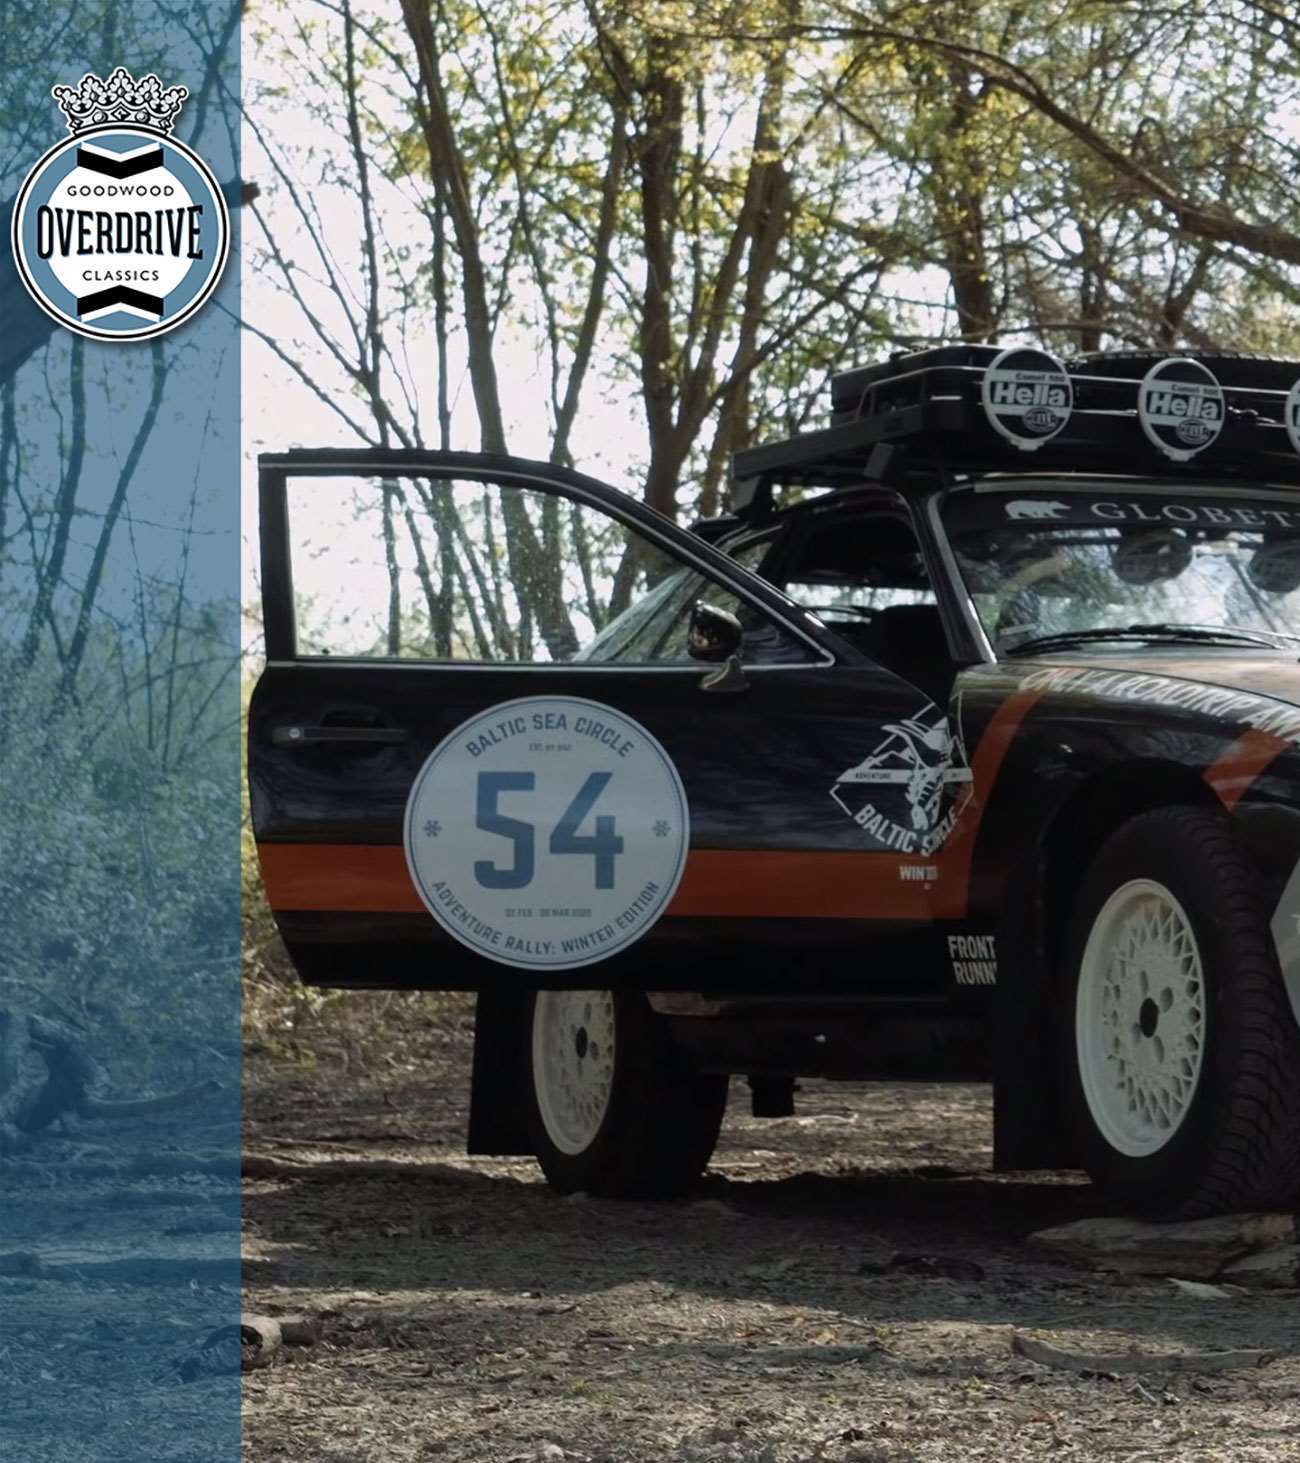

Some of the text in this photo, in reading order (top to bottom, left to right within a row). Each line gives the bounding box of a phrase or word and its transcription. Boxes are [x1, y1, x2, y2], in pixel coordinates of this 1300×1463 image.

[993, 381, 1066, 406] Hella
[1149, 391, 1218, 420] Hella
[466, 713, 635, 757] BALTIC SEA CIRCLE
[474, 771, 624, 890] 54
[854, 803, 918, 854] BALTIC
[432, 881, 660, 955] ADVENTURE RALLY: WINTER EDITION
[947, 935, 997, 960] FRONT
[952, 960, 998, 985] RUNN
